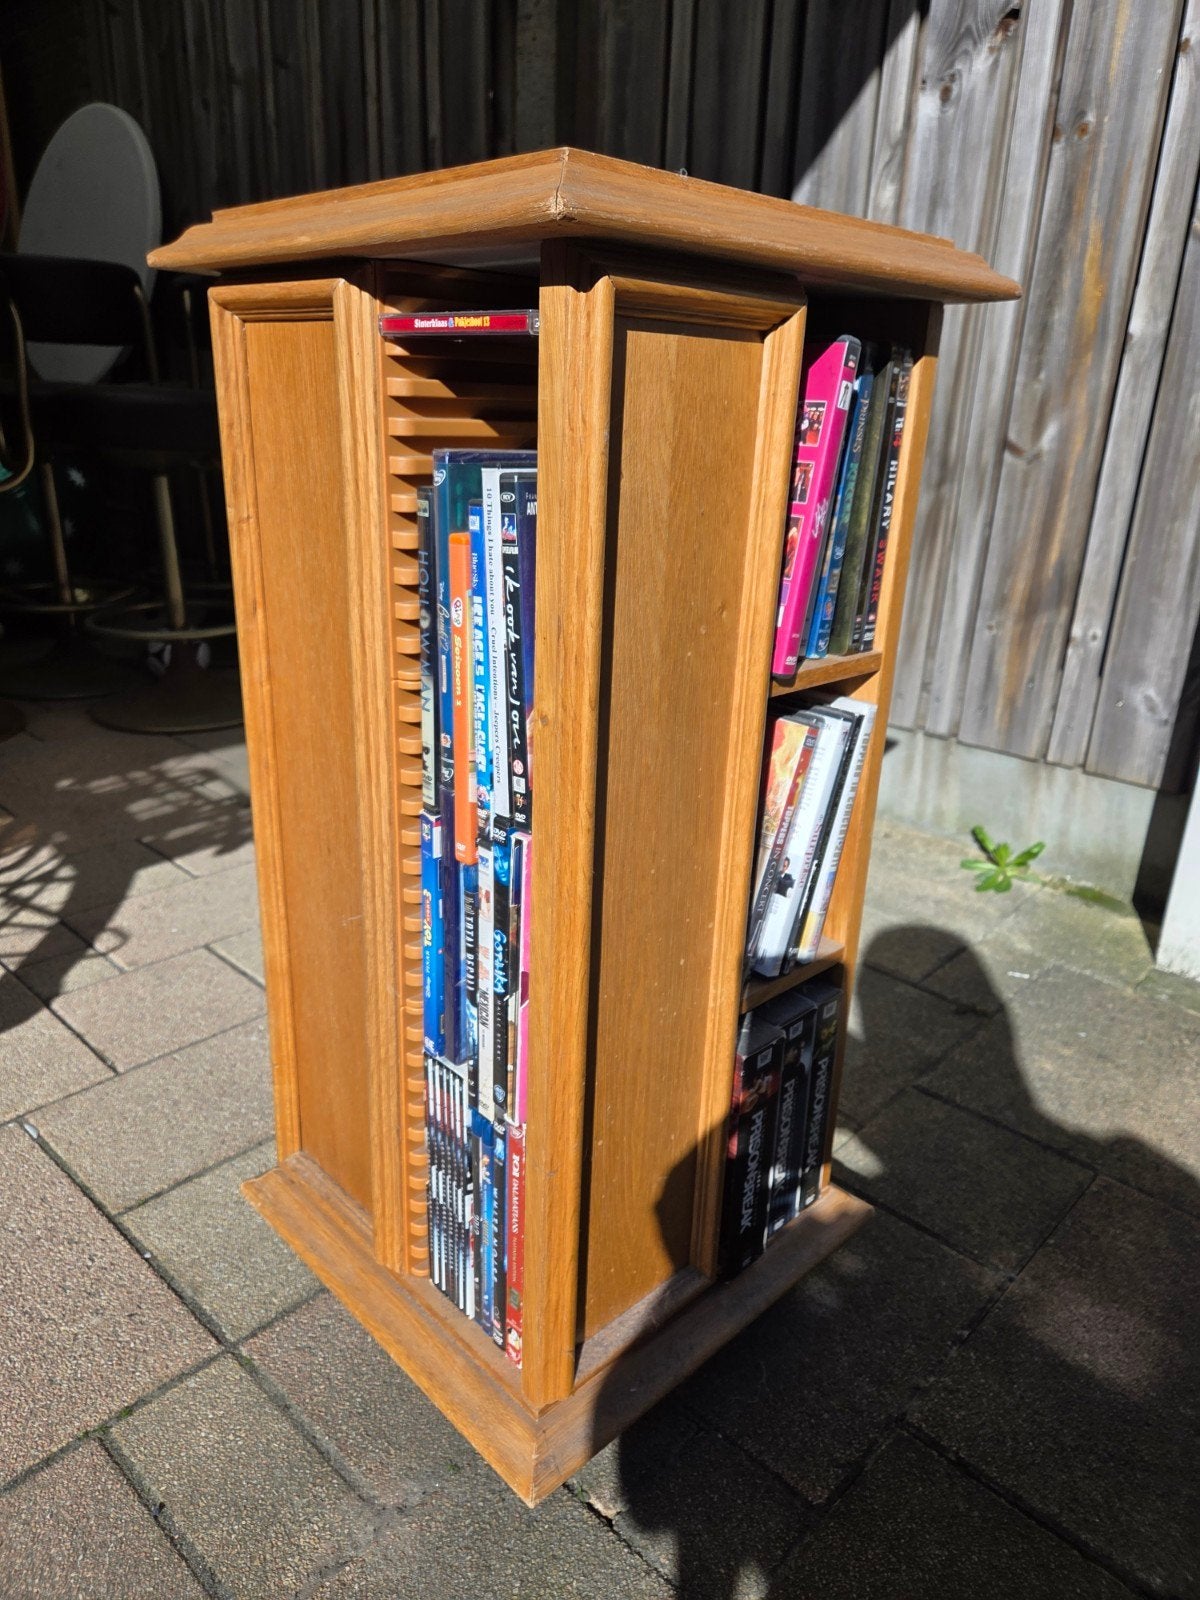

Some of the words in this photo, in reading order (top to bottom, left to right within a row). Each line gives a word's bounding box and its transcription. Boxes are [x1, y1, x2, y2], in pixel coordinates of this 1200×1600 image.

[414, 318, 447, 328] Sinterklaas
[853, 396, 869, 454] PRINSES
[486, 488, 492, 499] 10
[882, 459, 898, 530] HILARY
[871, 538, 888, 604] SWANK
[473, 595, 483, 627] ICE
[487, 598, 495, 615] you
[453, 634, 462, 695] Seizoen
[474, 628, 484, 661] AGE
[421, 660, 431, 712] MAN
[510, 652, 519, 695] van
[493, 710, 501, 743] Jeepers
[776, 805, 795, 845] TOPPERS
[772, 846, 783, 862] IN
[799, 822, 823, 888] Surprise
[755, 862, 778, 913] CONCERT
[423, 921, 432, 947] TOY
[479, 987, 489, 1029] MEXICAN
[511, 1153, 521, 1178] 101
[511, 1178, 520, 1234] DALMATIANS
